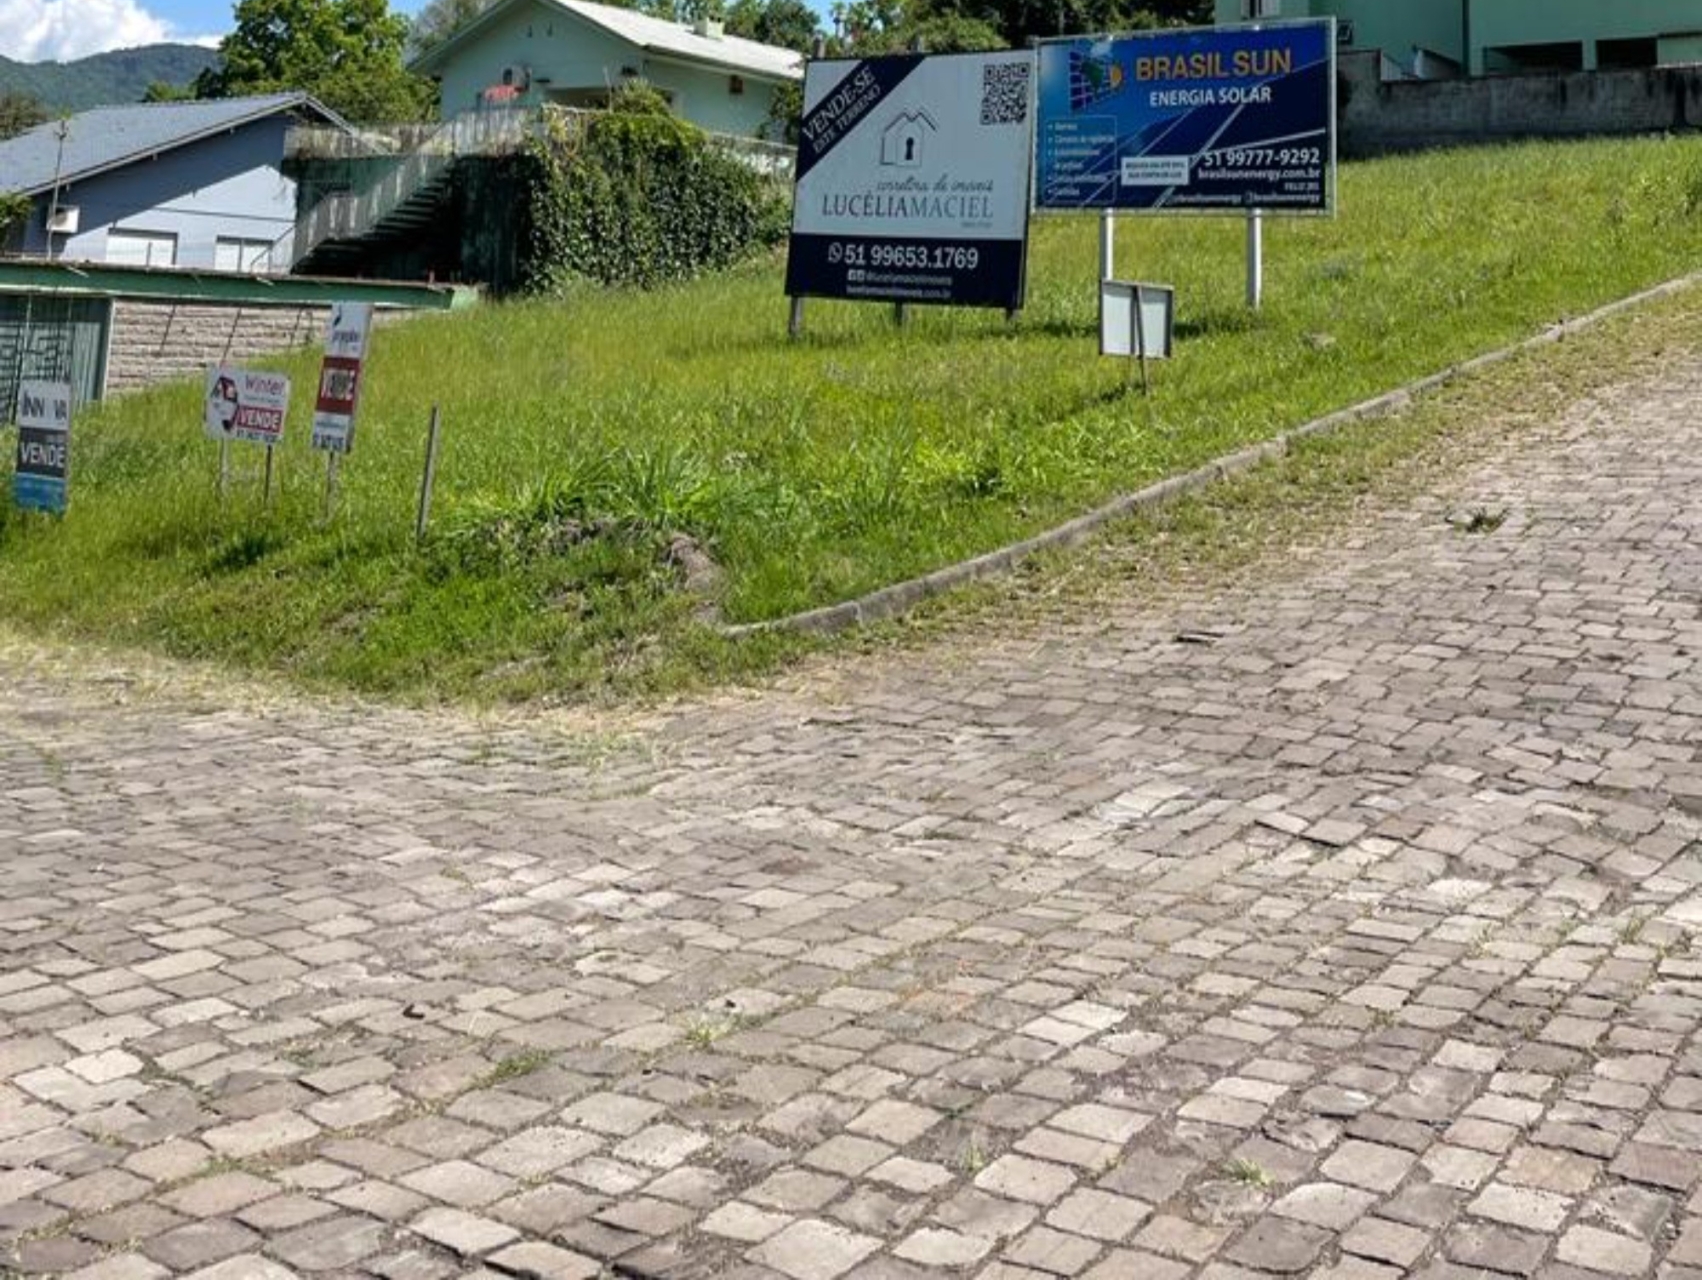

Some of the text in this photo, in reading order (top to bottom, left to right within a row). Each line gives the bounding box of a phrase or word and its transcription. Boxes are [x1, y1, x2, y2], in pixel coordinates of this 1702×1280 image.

[1136, 48, 1292, 81] BRASIL SUN
[802, 65, 876, 139] VENDE-SE
[1150, 86, 1272, 107] ENERGIA SOLAR
[1226, 147, 1320, 166] 99777-9292
[844, 243, 979, 270] 51 99653.1769
[238, 408, 282, 432] VENDE
[20, 441, 66, 469] VENDE
